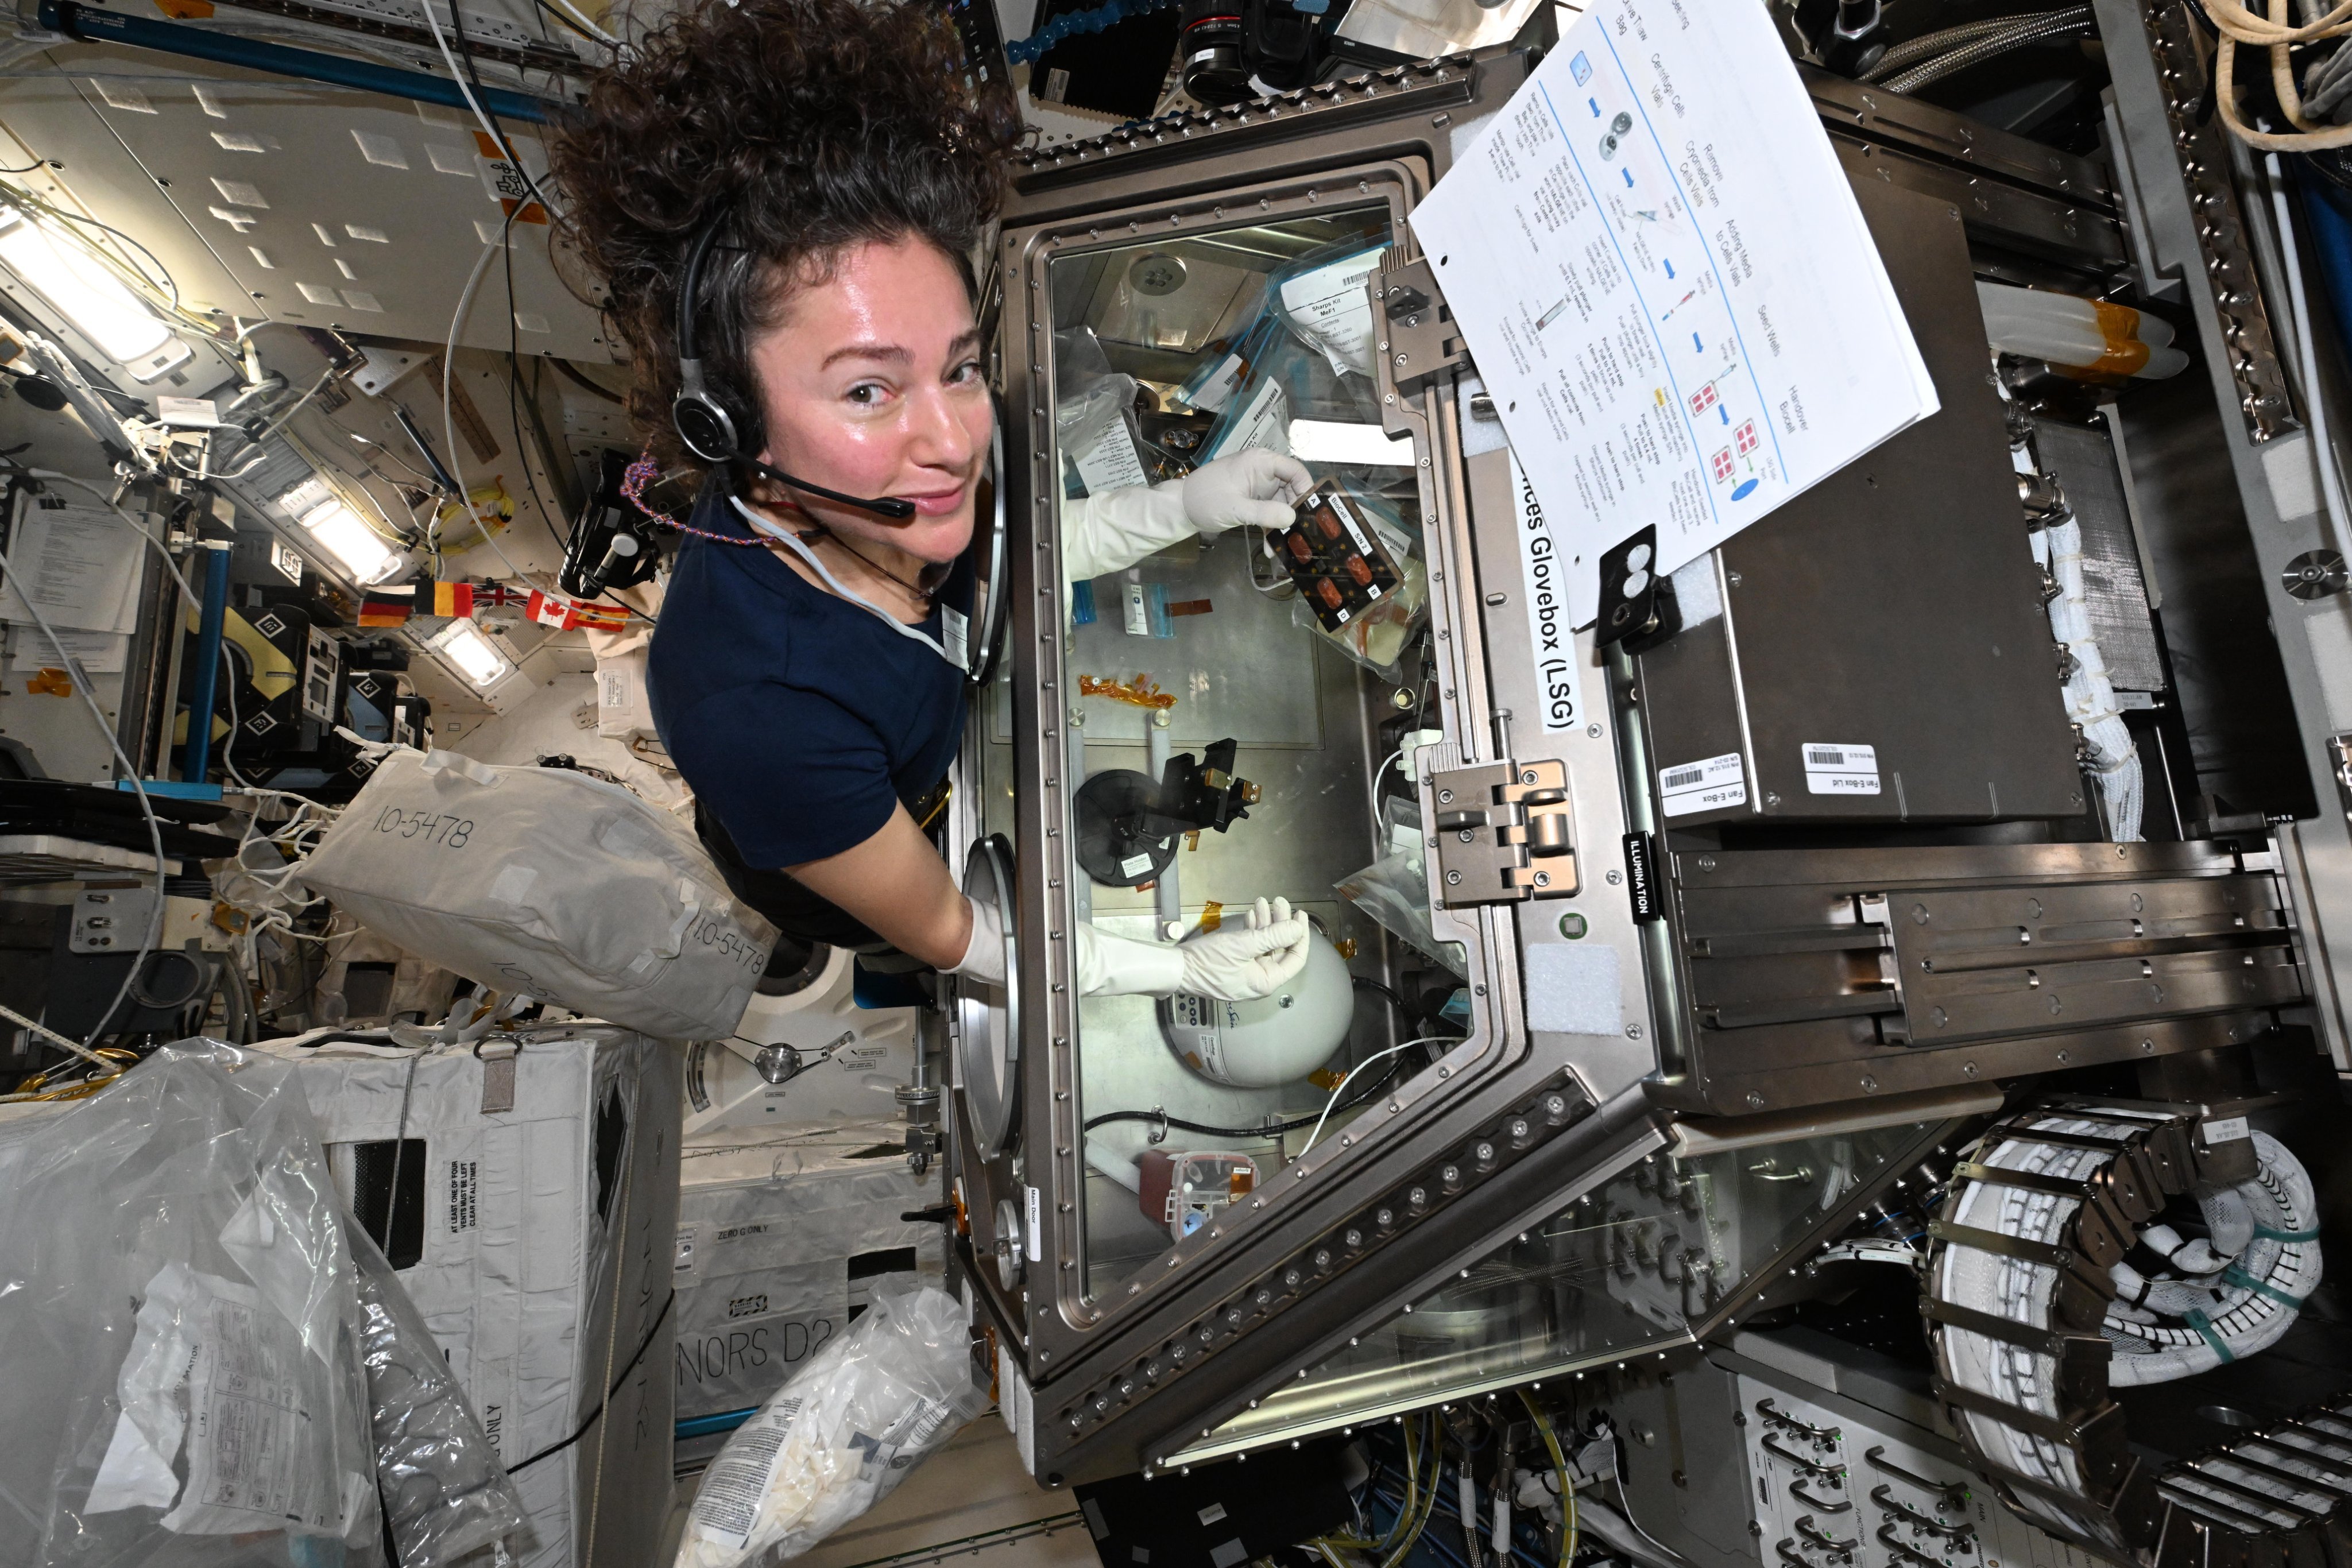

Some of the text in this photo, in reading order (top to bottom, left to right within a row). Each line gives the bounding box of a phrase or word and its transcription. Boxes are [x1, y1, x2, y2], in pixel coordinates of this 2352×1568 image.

[1614, 14, 1628, 35] Bag
[1650, 53, 1687, 118] Centrifuge Cells
[1650, 85, 1665, 107] Vials
[1684, 141, 1720, 207] Cryomedia from
[1704, 145, 1724, 181] Remove
[1680, 162, 1705, 207] Cells Vials
[1671, 195, 1682, 212] Waste
[1719, 241, 1734, 264] Cells
[1728, 264, 1742, 286] Vials
[1723, 220, 1754, 278] Adding Media
[1312, 301, 1332, 312] Sharps
[1320, 308, 1336, 316] MeF1
[1579, 291, 1592, 312] plunger
[1321, 318, 1340, 328] Contents
[1757, 305, 1782, 356] Seed Wells
[1598, 349, 1606, 361] Pull
[1601, 338, 1611, 352] Push
[1610, 359, 1619, 373] hard
[1558, 369, 1566, 381] Pull
[1577, 412, 1586, 425] from
[1788, 387, 1809, 430] Handover
[1639, 414, 1649, 429] Push
[1648, 437, 1656, 450] hard
[1779, 402, 1796, 433] Biocell
[1604, 442, 1613, 456] Push
[1612, 464, 1620, 477] hard
[1311, 497, 1317, 505] A
[1330, 497, 1348, 520] BioCell
[1354, 532, 1364, 546] S/N
[1529, 536, 1574, 730] Glovebox (LSG)
[1703, 789, 1743, 803] Fan E-Box
[1630, 840, 1649, 914] ILLUMINATION
[451, 1179, 458, 1188] OF
[461, 1179, 467, 1188] BE
[470, 1194, 475, 1204] AT
[718, 1229, 738, 1240] ZERO
[748, 1225, 769, 1234] ONLY
[678, 1327, 768, 1386] NORS
[486, 1406, 501, 1445] ONLY
[1855, 1507, 1866, 1547] FUNCTIONS
[1977, 1502, 1986, 1523] MAIN
